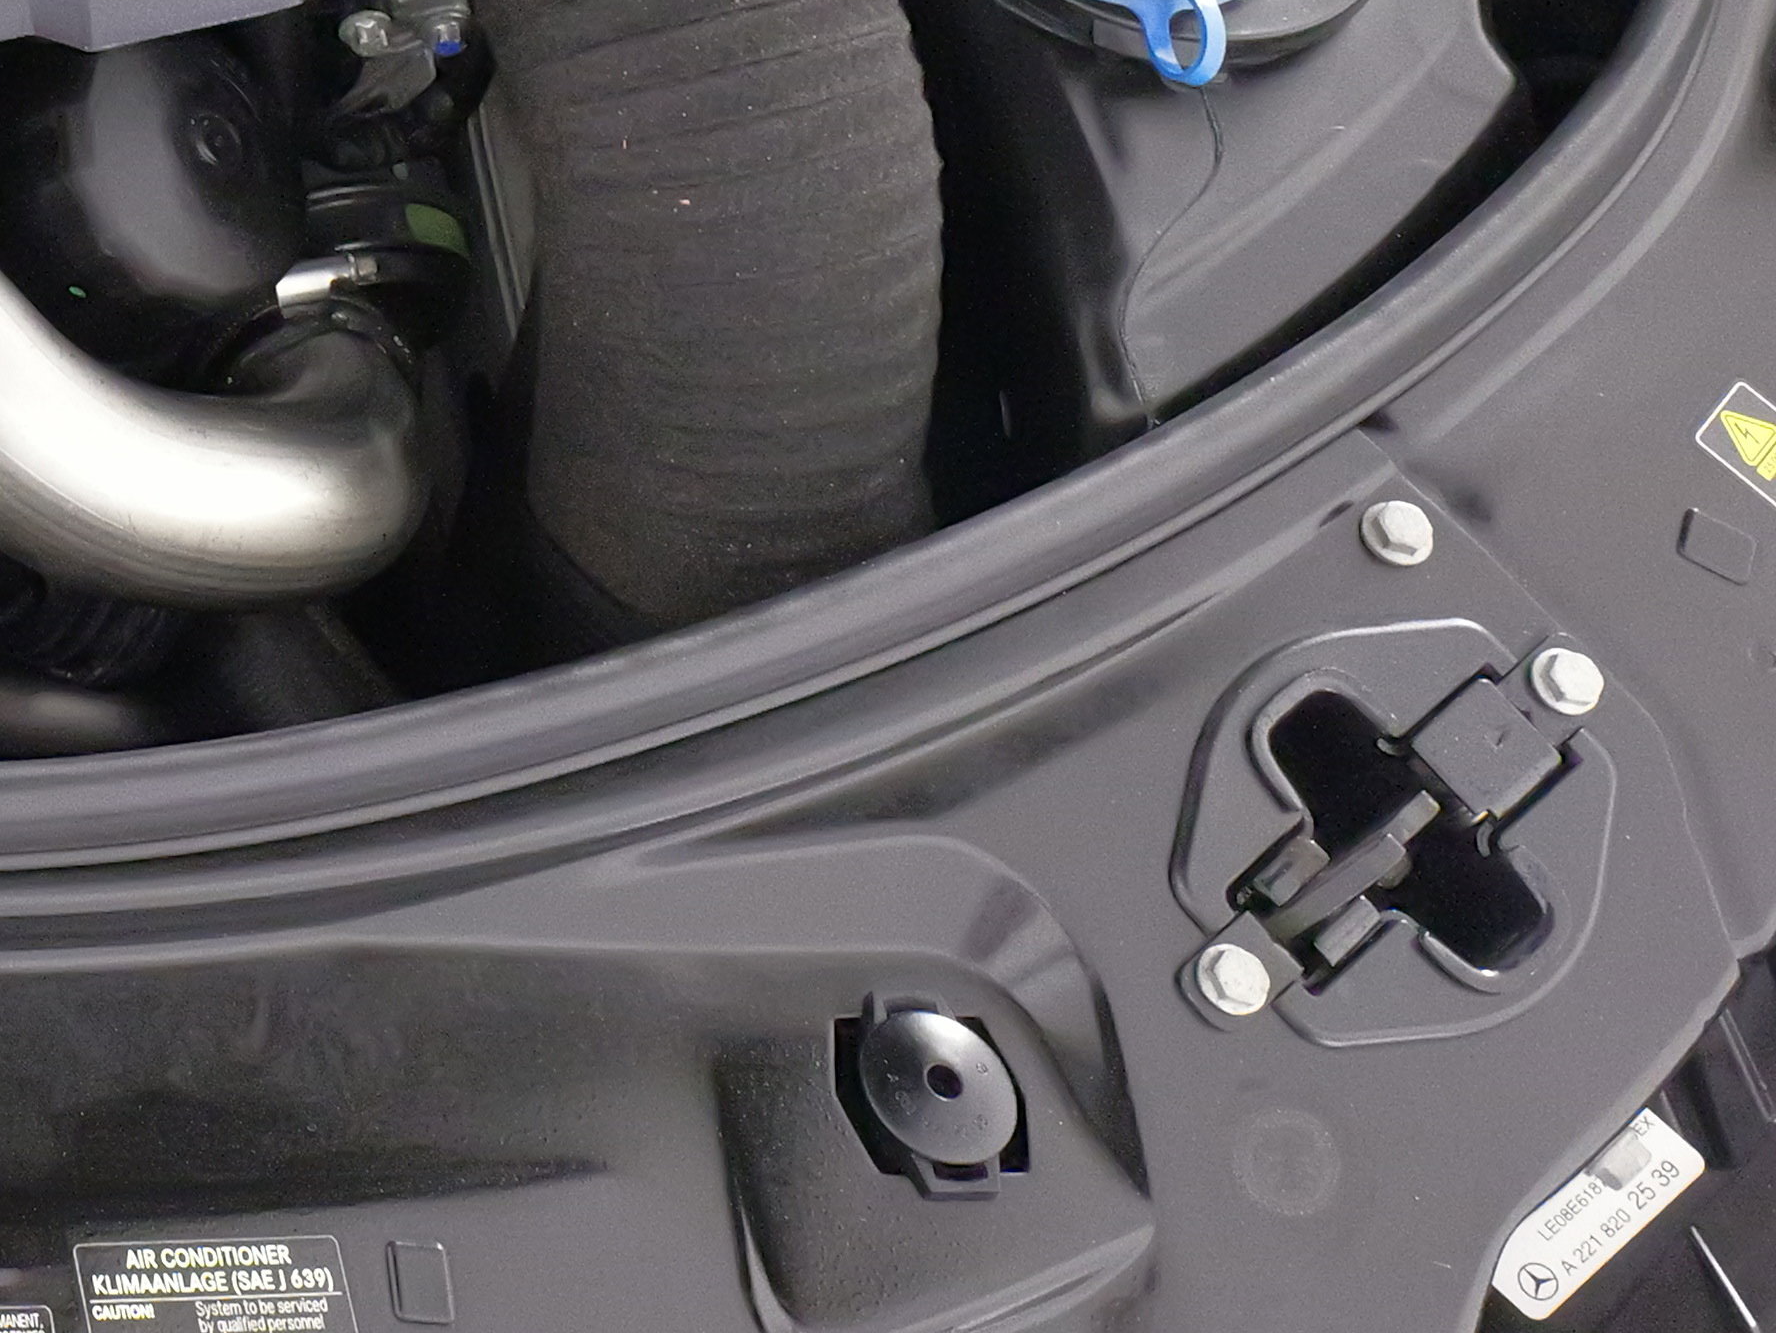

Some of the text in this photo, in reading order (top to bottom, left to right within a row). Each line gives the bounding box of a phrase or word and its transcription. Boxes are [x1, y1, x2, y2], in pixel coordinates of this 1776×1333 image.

[1560, 1159, 1681, 1277] A 221 820 25 39
[126, 1245, 292, 1270] AIR CONDITIONER
[91, 1267, 335, 1296] KLIMAANLAGE (SAE J 639)
[91, 1303, 155, 1321] CAUTION!
[195, 1296, 329, 1321] System to be serviced
[199, 1313, 325, 1333] by qualified personnel
